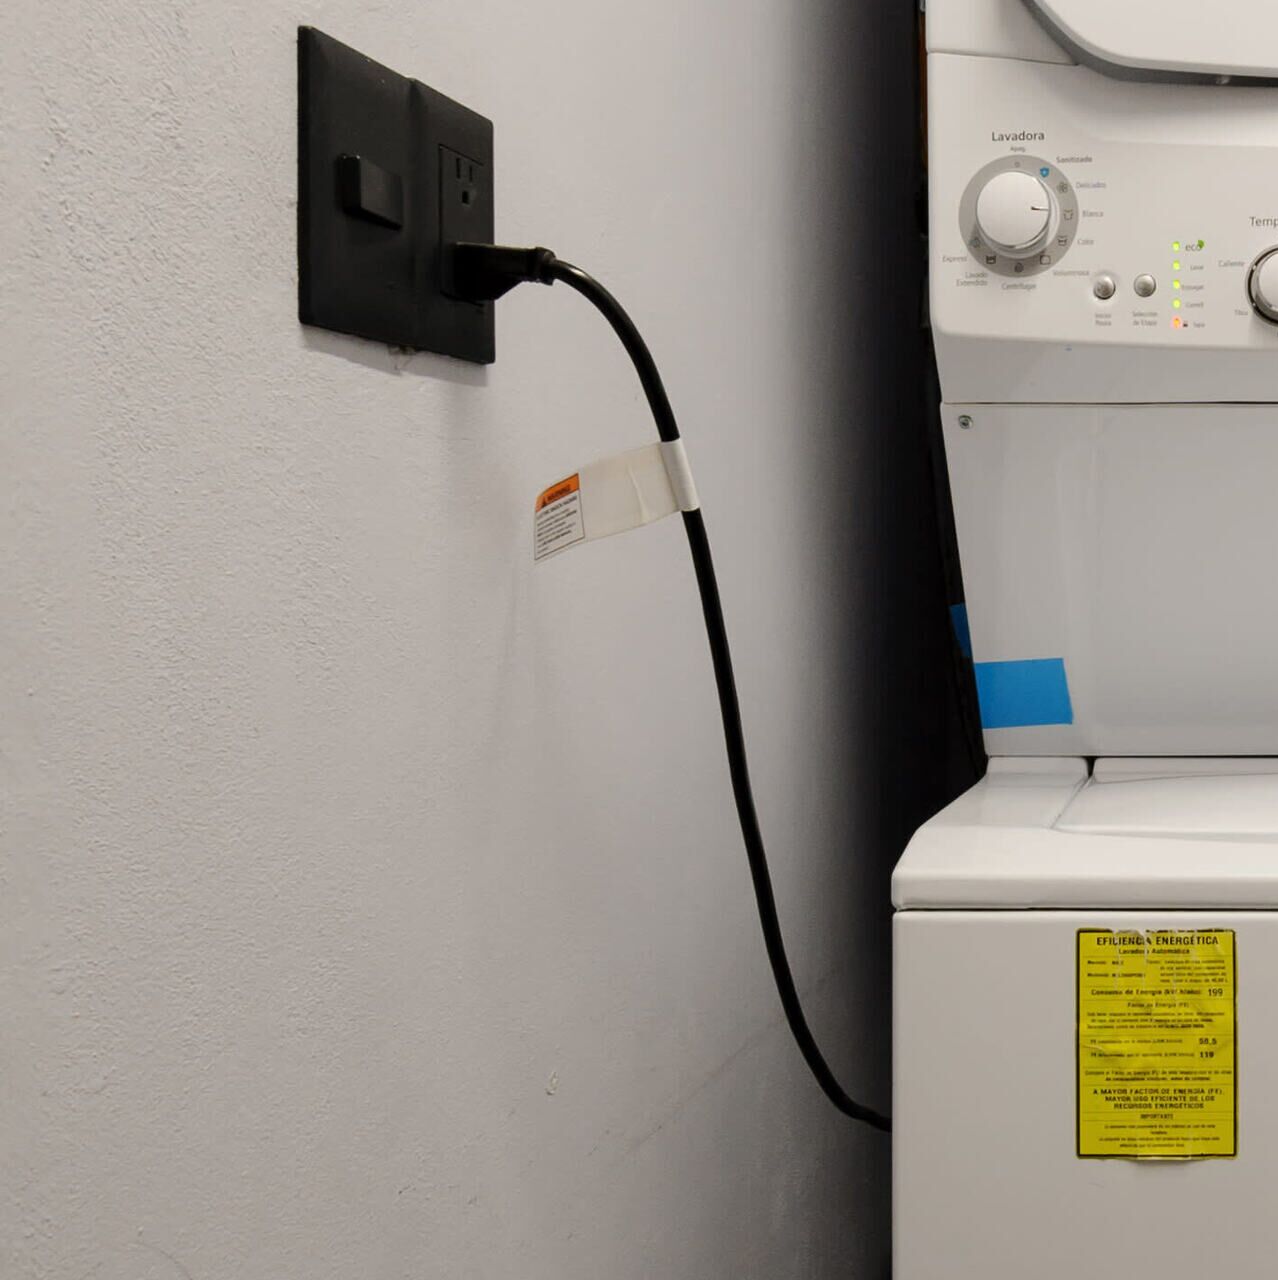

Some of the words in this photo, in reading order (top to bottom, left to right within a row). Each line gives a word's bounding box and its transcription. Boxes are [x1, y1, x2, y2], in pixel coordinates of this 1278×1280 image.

[991, 130, 1046, 142] Lavadora
[1185, 243, 1203, 252] eco
[1155, 934, 1219, 946] ENERGÉTICA
[1208, 987, 1224, 997] 199
